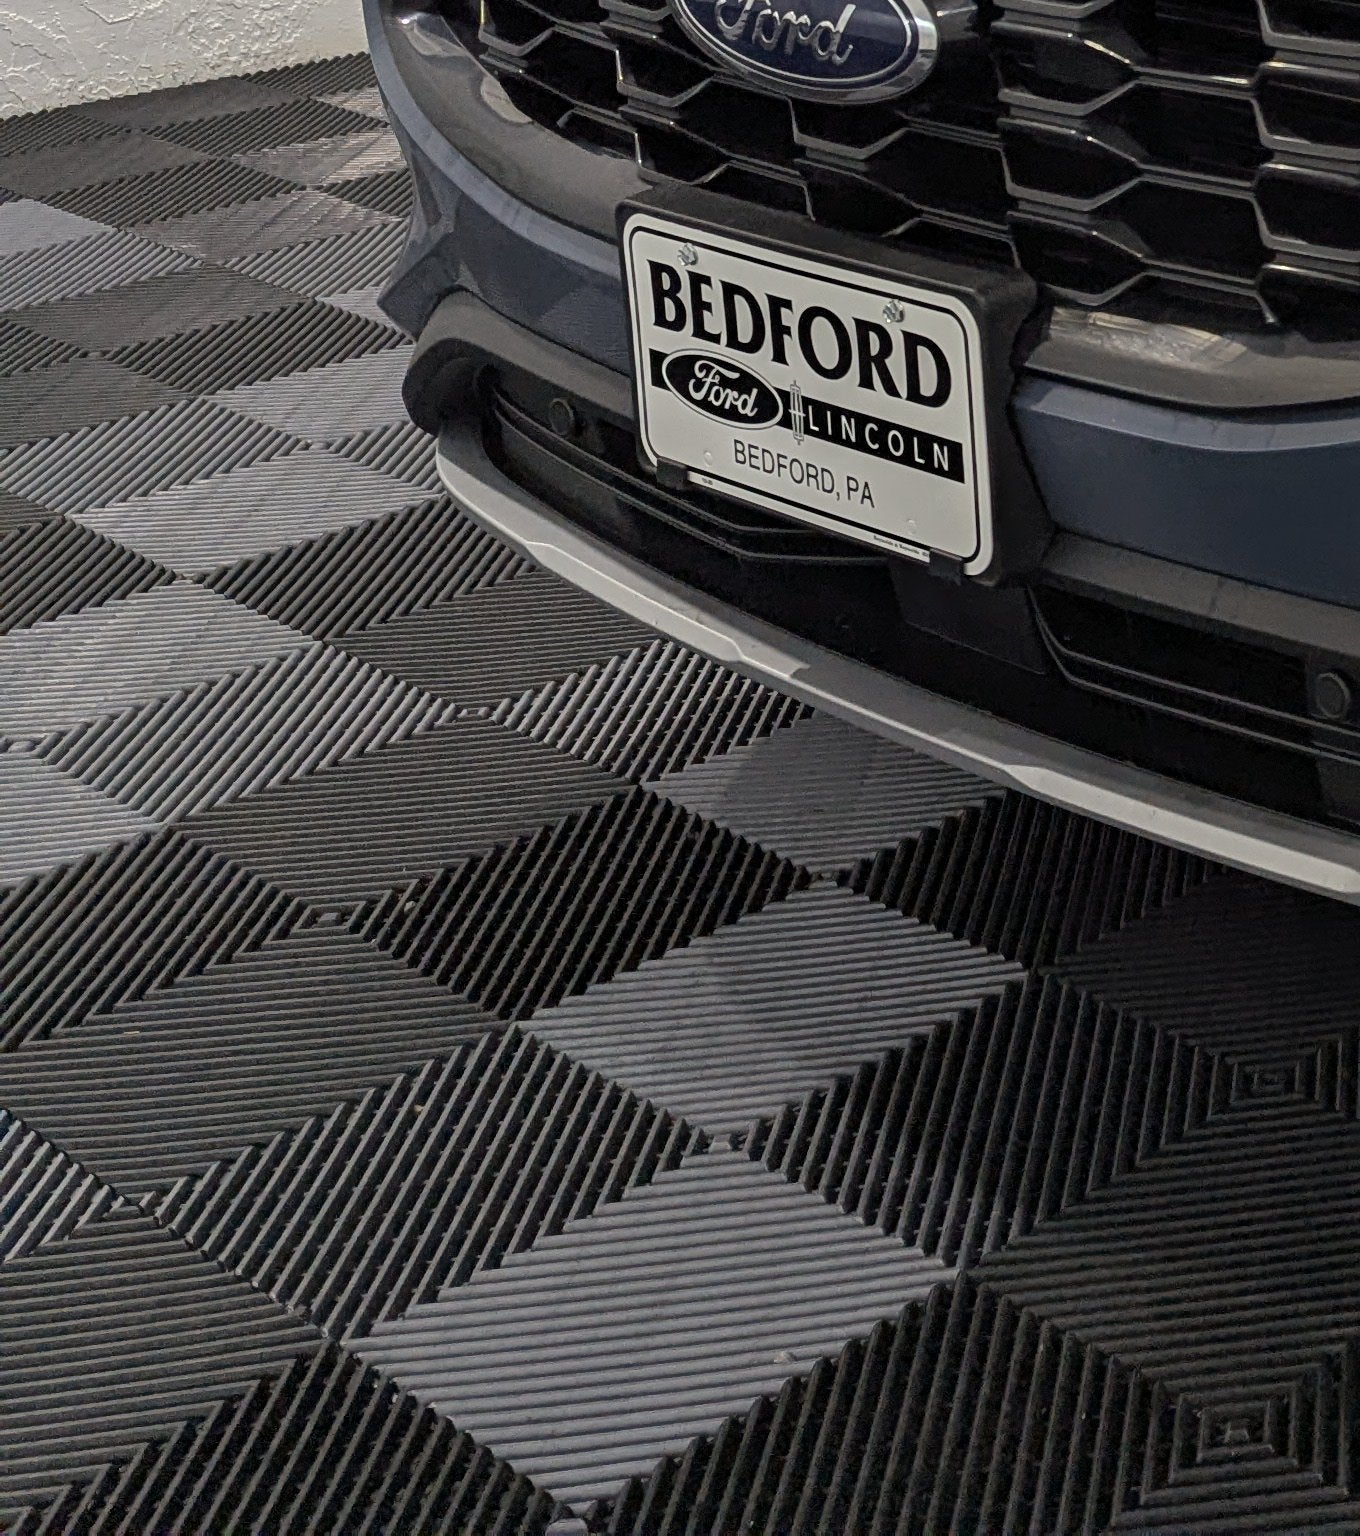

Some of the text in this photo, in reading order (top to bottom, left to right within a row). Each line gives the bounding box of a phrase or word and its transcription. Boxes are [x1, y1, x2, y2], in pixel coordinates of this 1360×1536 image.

[646, 258, 952, 409] BEDFORD
[688, 358, 759, 419] Ford
[807, 401, 951, 472] LINCOLN
[733, 438, 875, 509] BEDFORD, PA
